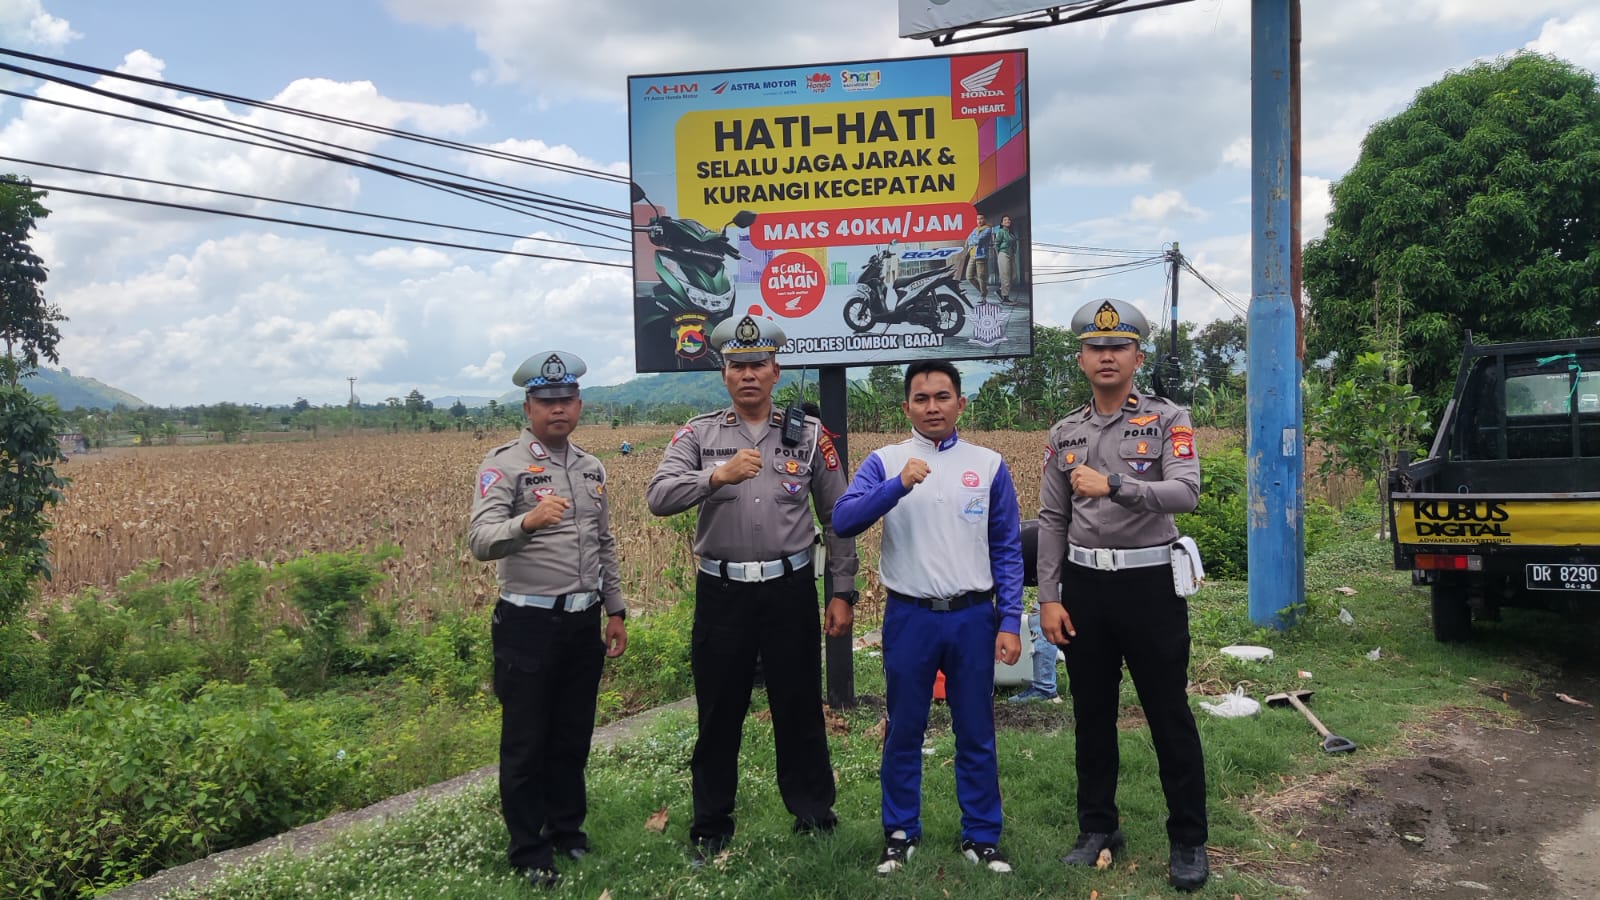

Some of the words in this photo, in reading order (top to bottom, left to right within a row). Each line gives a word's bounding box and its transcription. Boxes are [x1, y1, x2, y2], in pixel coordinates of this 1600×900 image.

[645, 82, 699, 95] AHM
[731, 81, 761, 91] ASTRA
[763, 80, 797, 89] MOTOR
[961, 90, 1005, 98] HONDA
[961, 106, 977, 115] One
[978, 104, 1006, 113] HEART.
[714, 107, 935, 152] HATI-HATI
[696, 157, 777, 179] SELALU
[782, 153, 848, 174] JAGA
[852, 148, 932, 170] JARAK
[937, 147, 956, 165] &
[703, 181, 809, 205] KURANGI
[814, 173, 955, 199] KECEPATAN
[763, 221, 830, 241] MAKS
[835, 211, 963, 238] 40KM/JAM
[777, 338, 795, 353] AS
[798, 337, 843, 353] POLRES
[846, 335, 898, 351] LOMBOK
[904, 333, 944, 348] BARAT
[1124, 427, 1158, 438] POLRI
[774, 447, 809, 459] POLRI
[1414, 500, 1509, 522] KUBUS
[1415, 522, 1511, 537] DIGITAL
[1532, 566, 1552, 582] DR
[1560, 566, 1598, 583] 8290
